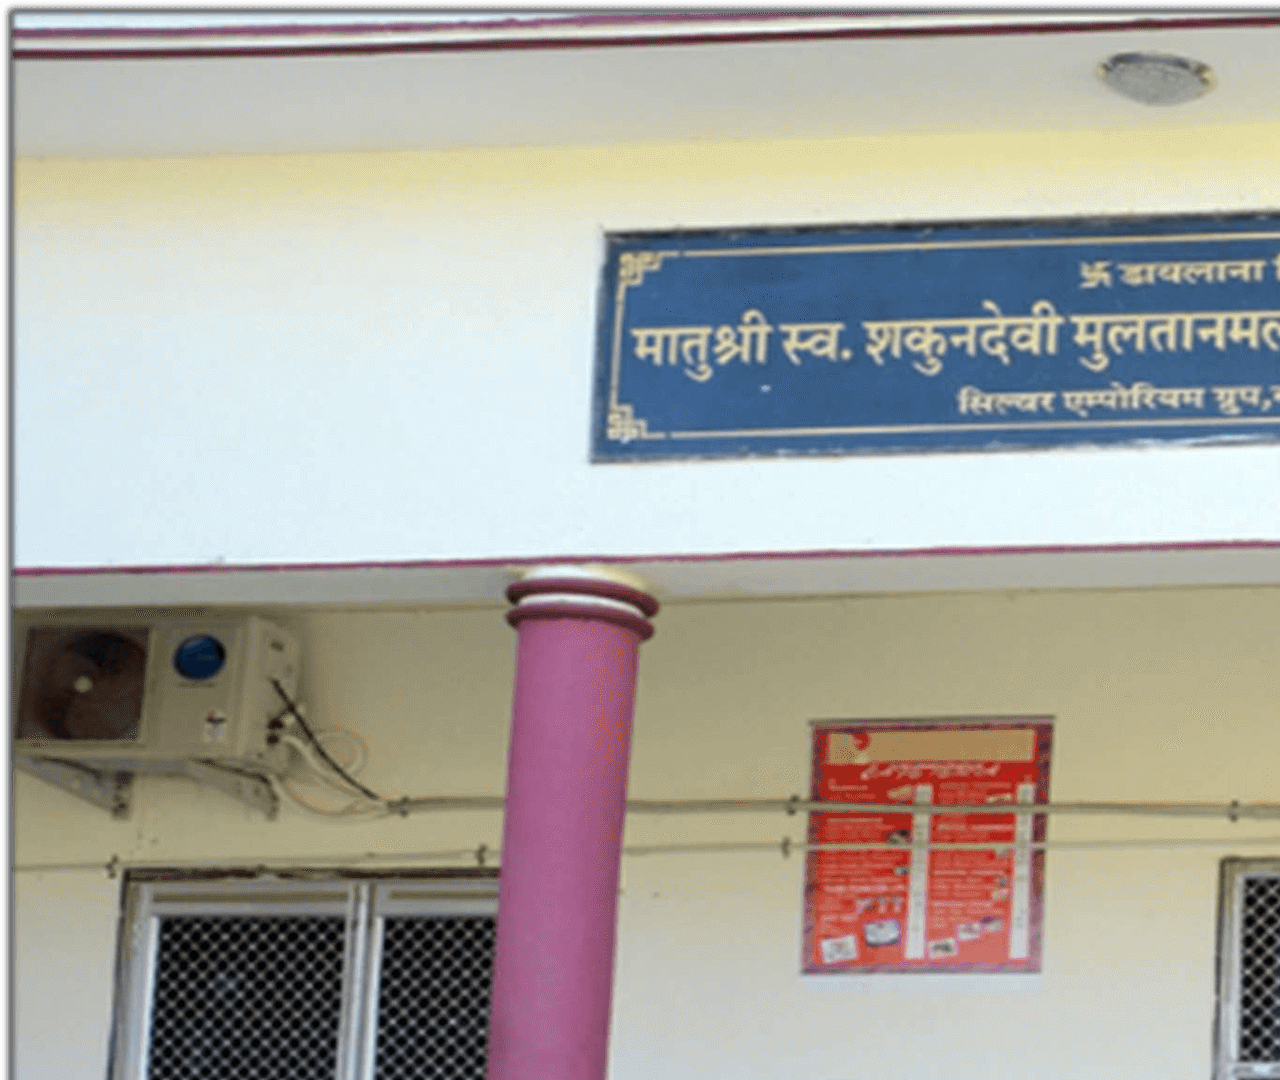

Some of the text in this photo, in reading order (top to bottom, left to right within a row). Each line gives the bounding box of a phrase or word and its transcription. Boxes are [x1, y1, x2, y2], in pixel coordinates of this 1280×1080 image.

[1118, 258, 1266, 285] डायलाना
[629, 309, 773, 382] मातुश्री
[779, 321, 853, 365] स्व.
[862, 300, 1062, 376] शकुनदेवी
